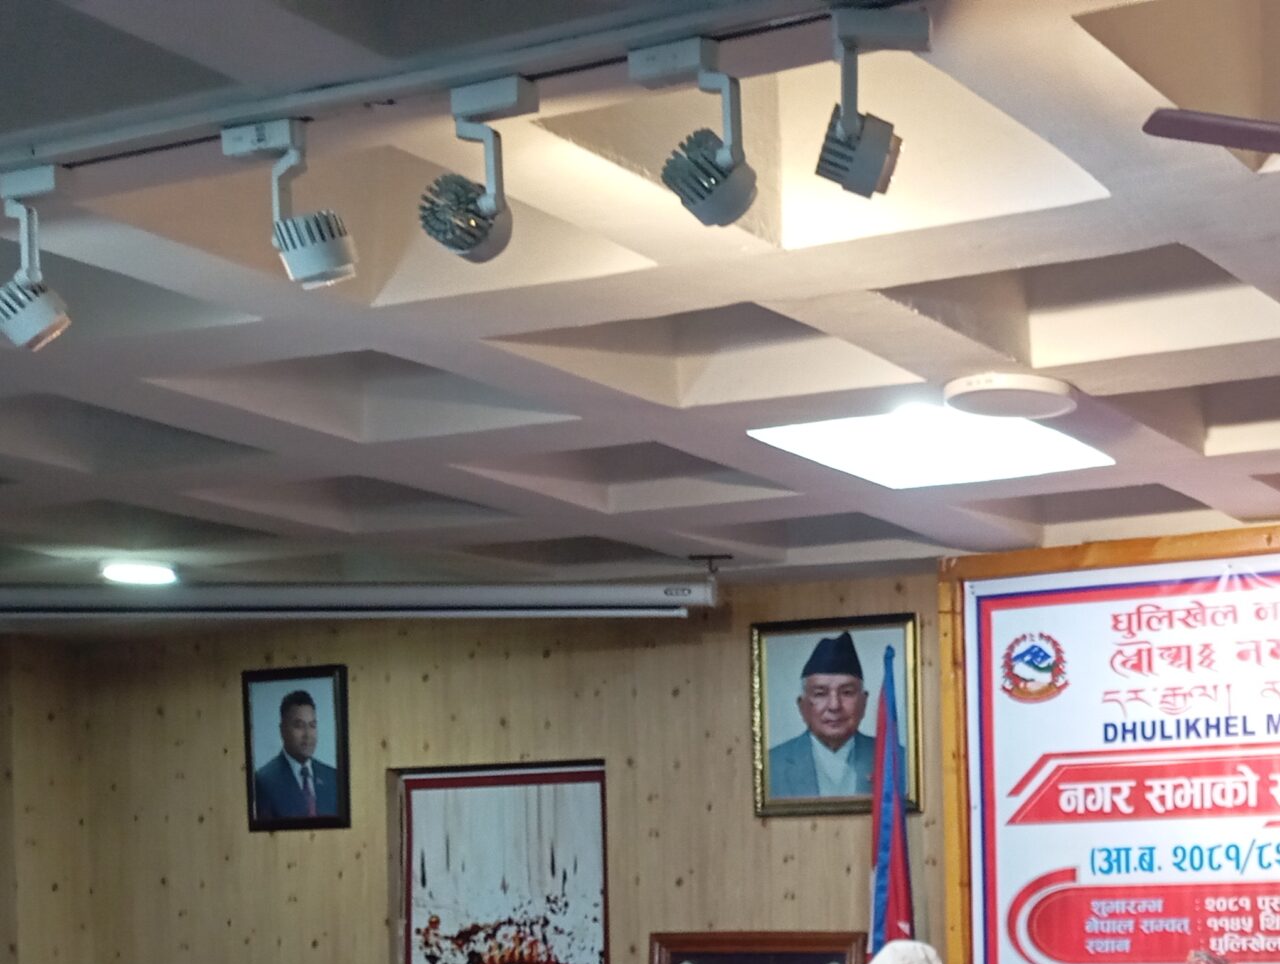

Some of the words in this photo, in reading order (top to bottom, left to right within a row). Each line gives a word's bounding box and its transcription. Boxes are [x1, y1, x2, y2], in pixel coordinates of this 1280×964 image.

[1111, 600, 1238, 638] धुलिखेल
[1103, 715, 1256, 744] DHULIKHEL
[1058, 779, 1137, 814] नगर
[1144, 763, 1260, 814] सभाको
[1204, 896, 1252, 912] २०८१
[1085, 917, 1135, 934] नेपाल
[1206, 916, 1254, 933] ११४५
[1085, 938, 1131, 955] स्थान
